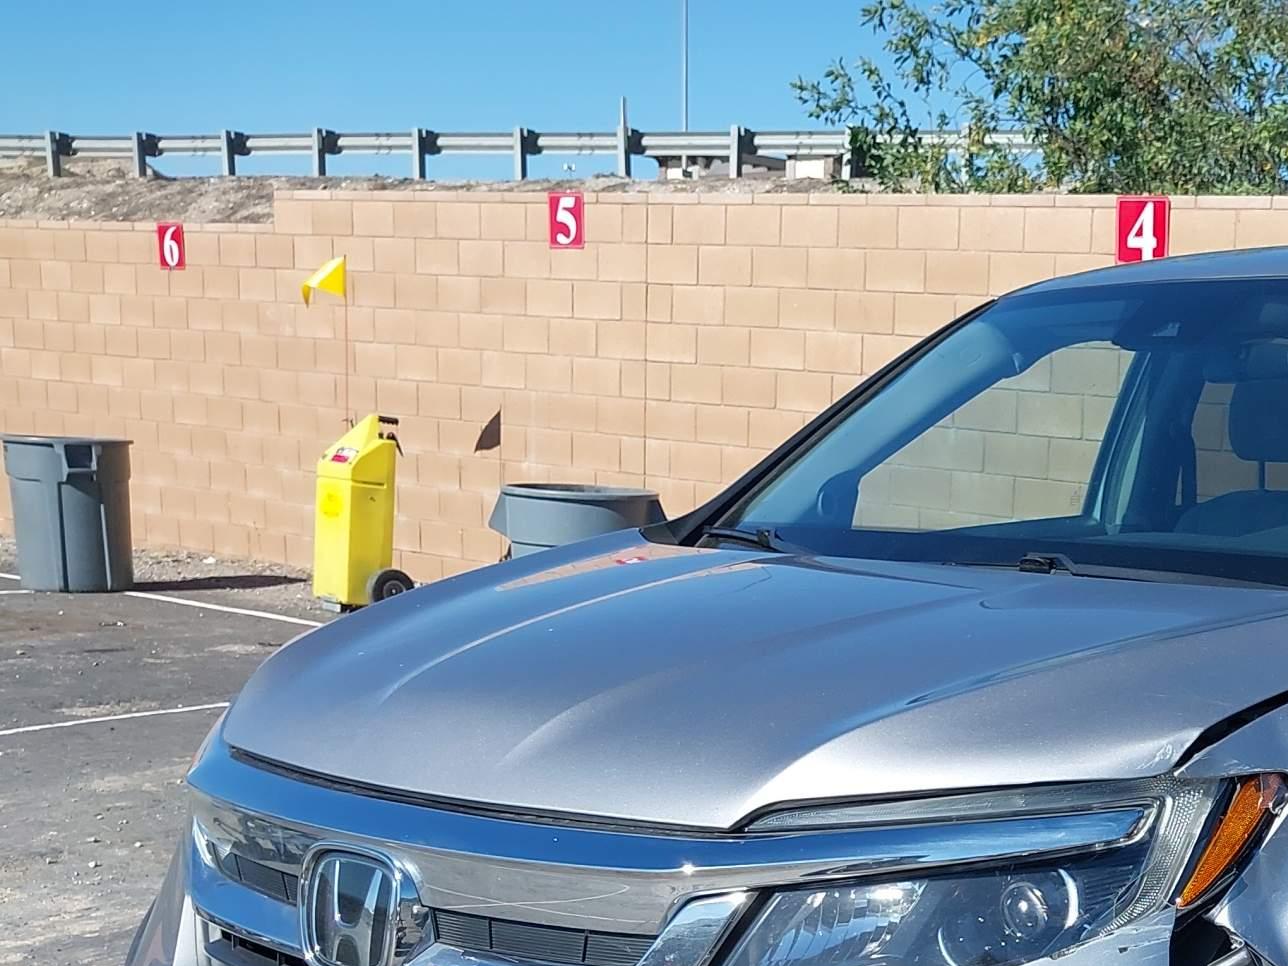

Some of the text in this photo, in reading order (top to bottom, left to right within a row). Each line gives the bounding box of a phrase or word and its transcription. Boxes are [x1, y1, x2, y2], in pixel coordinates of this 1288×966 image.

[556, 196, 577, 246] 5
[1126, 201, 1158, 261] 4
[163, 226, 180, 267] 6
